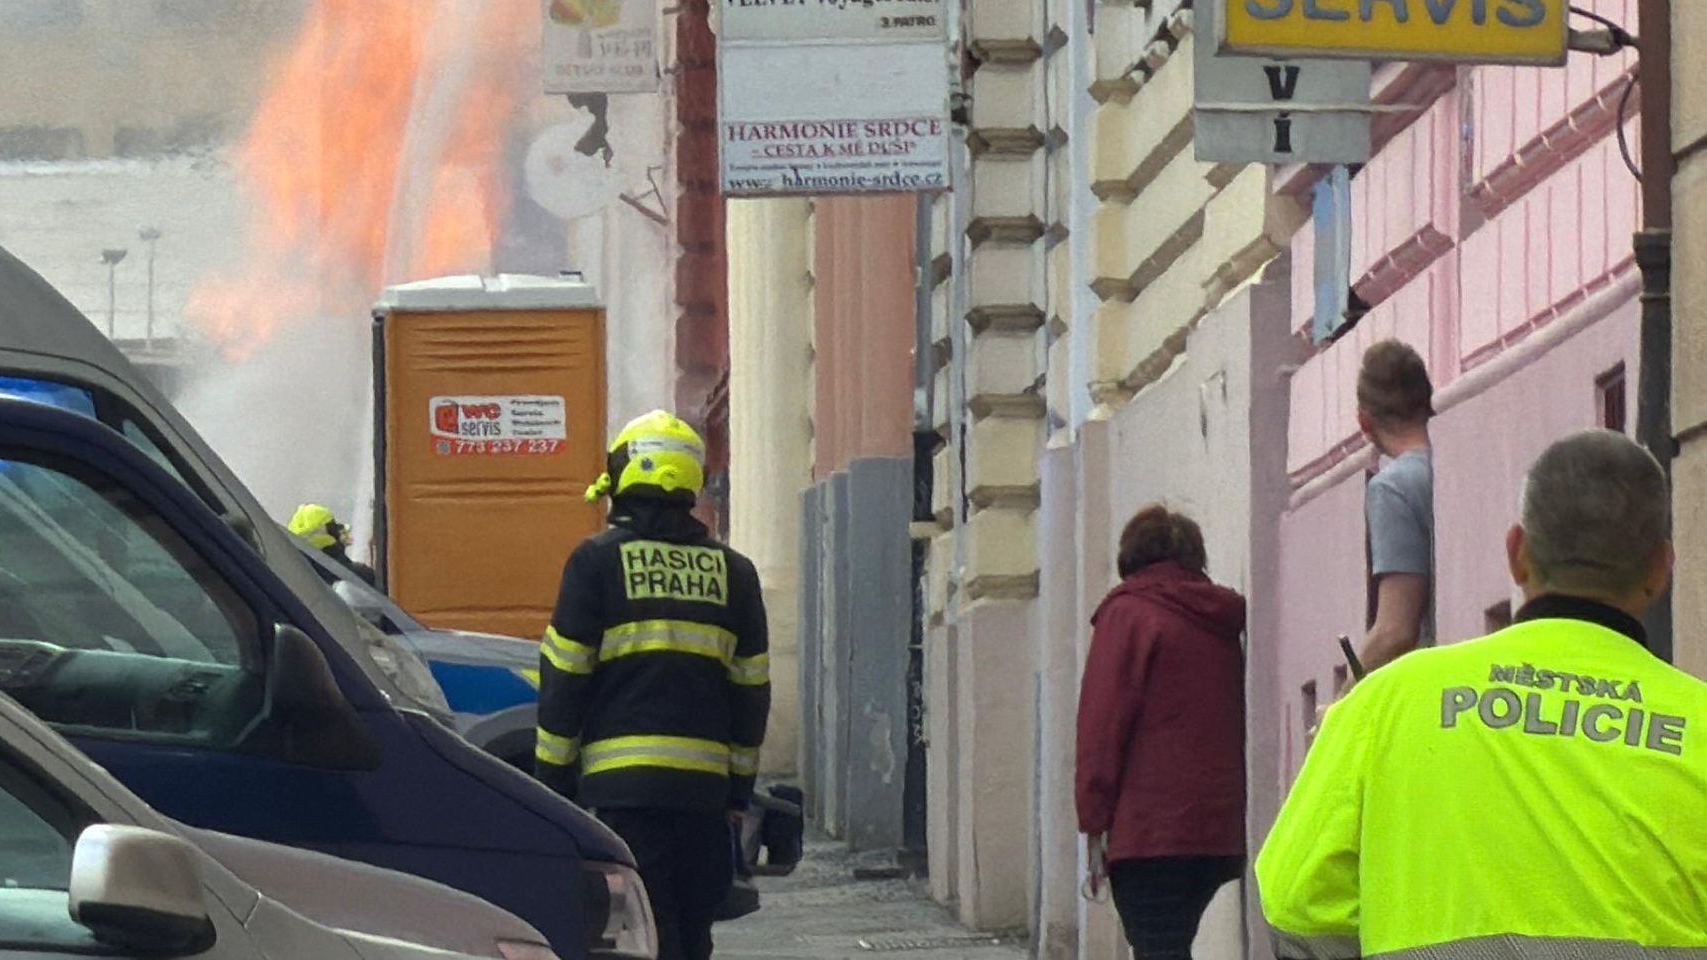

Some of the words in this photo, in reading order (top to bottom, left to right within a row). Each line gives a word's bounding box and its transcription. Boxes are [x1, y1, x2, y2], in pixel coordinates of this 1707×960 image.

[728, 123, 857, 141] HARMONIE
[864, 119, 942, 138] SRDCE
[764, 143, 818, 158] CESTA
[823, 143, 835, 157] K
[461, 420, 502, 436] servis
[630, 570, 723, 600] PRAHA
[1440, 685, 1686, 756] POLICIE
